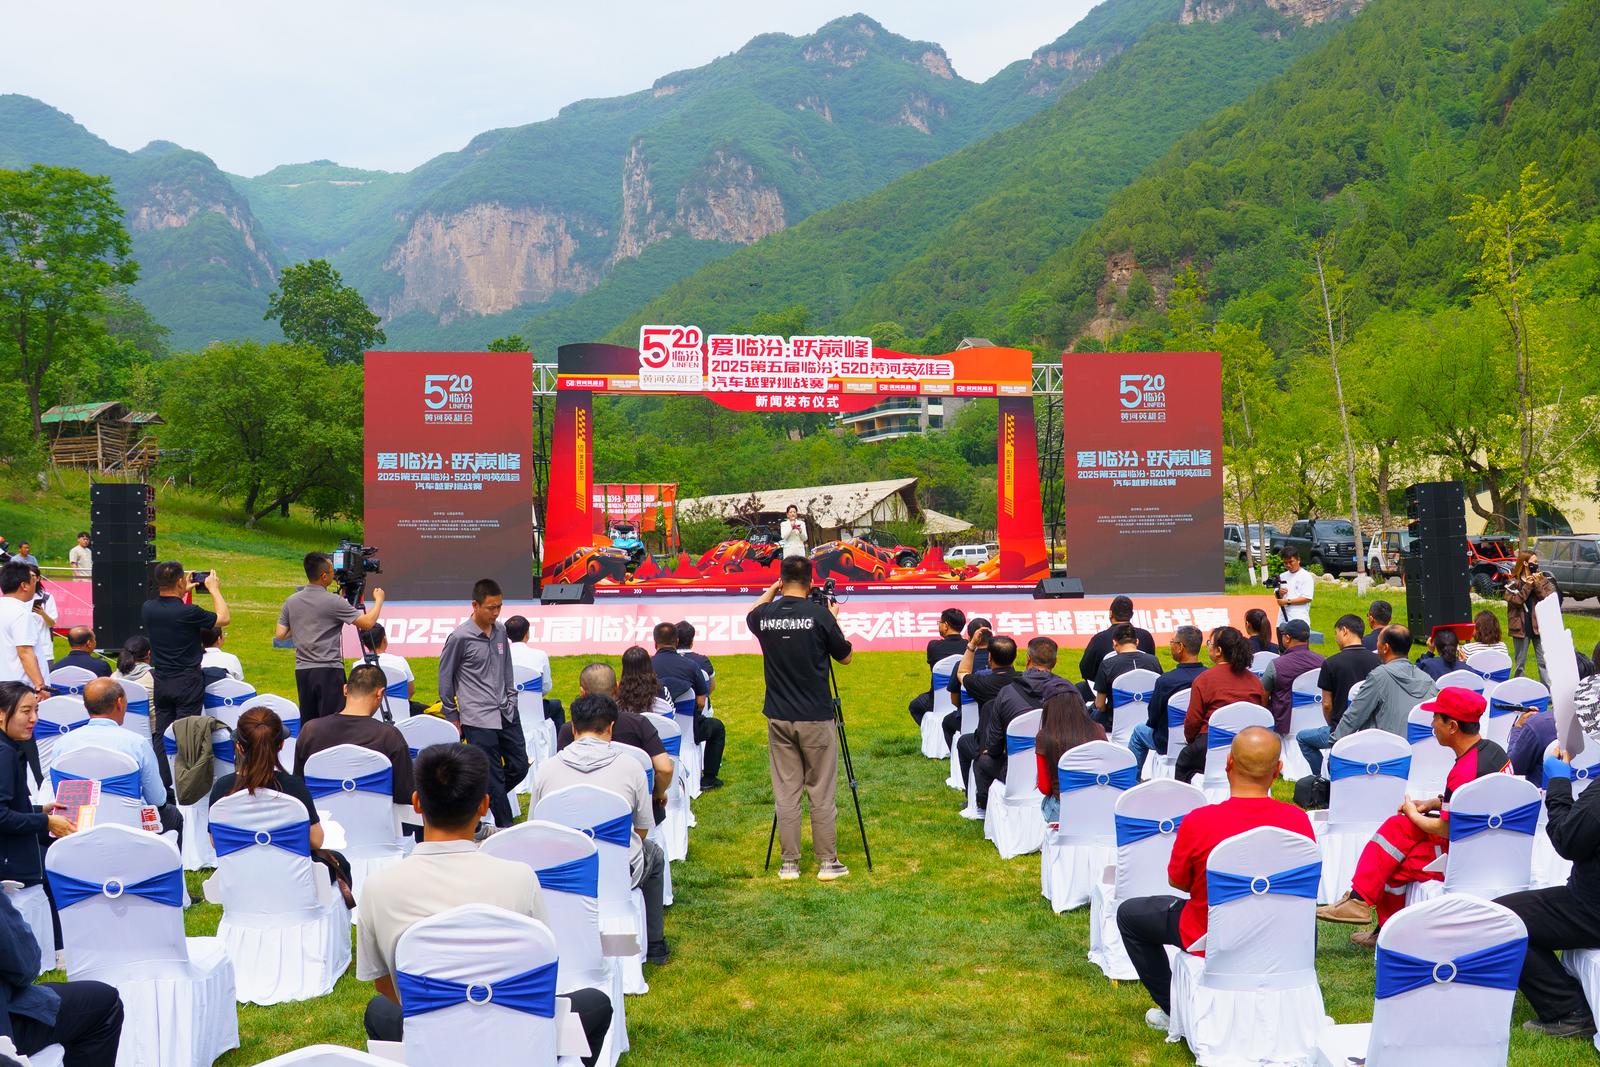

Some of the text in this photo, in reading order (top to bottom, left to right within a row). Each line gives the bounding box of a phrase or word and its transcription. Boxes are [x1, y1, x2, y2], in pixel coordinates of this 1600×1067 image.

[672, 350, 699, 361] 临汾
[711, 376, 824, 389] 汽车越野挑战赛
[449, 393, 472, 403] 临汾
[755, 395, 840, 408] 新闻发布仪式
[1143, 392, 1165, 402] 临汾
